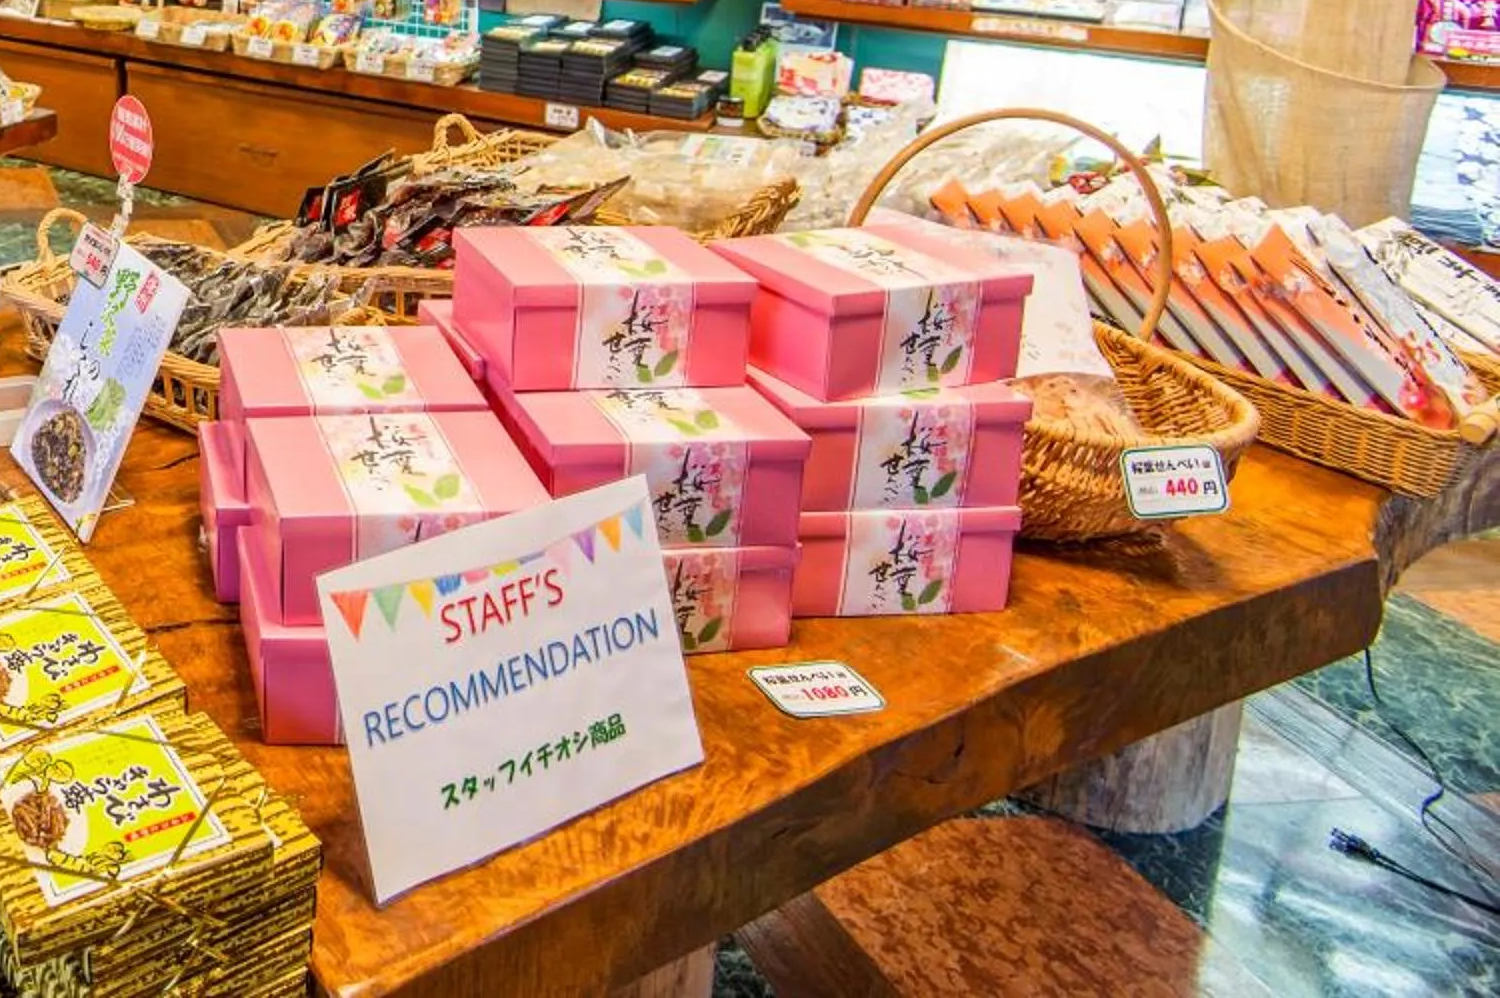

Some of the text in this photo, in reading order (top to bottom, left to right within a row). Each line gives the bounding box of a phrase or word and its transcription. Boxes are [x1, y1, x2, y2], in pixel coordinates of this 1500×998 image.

[439, 568, 565, 645] STAFF'S
[42, 639, 106, 681] わさび
[363, 607, 659, 748] RECOMMENDATION
[439, 711, 628, 810] スタッフイチオシ商品
[106, 777, 182, 826] わさび
